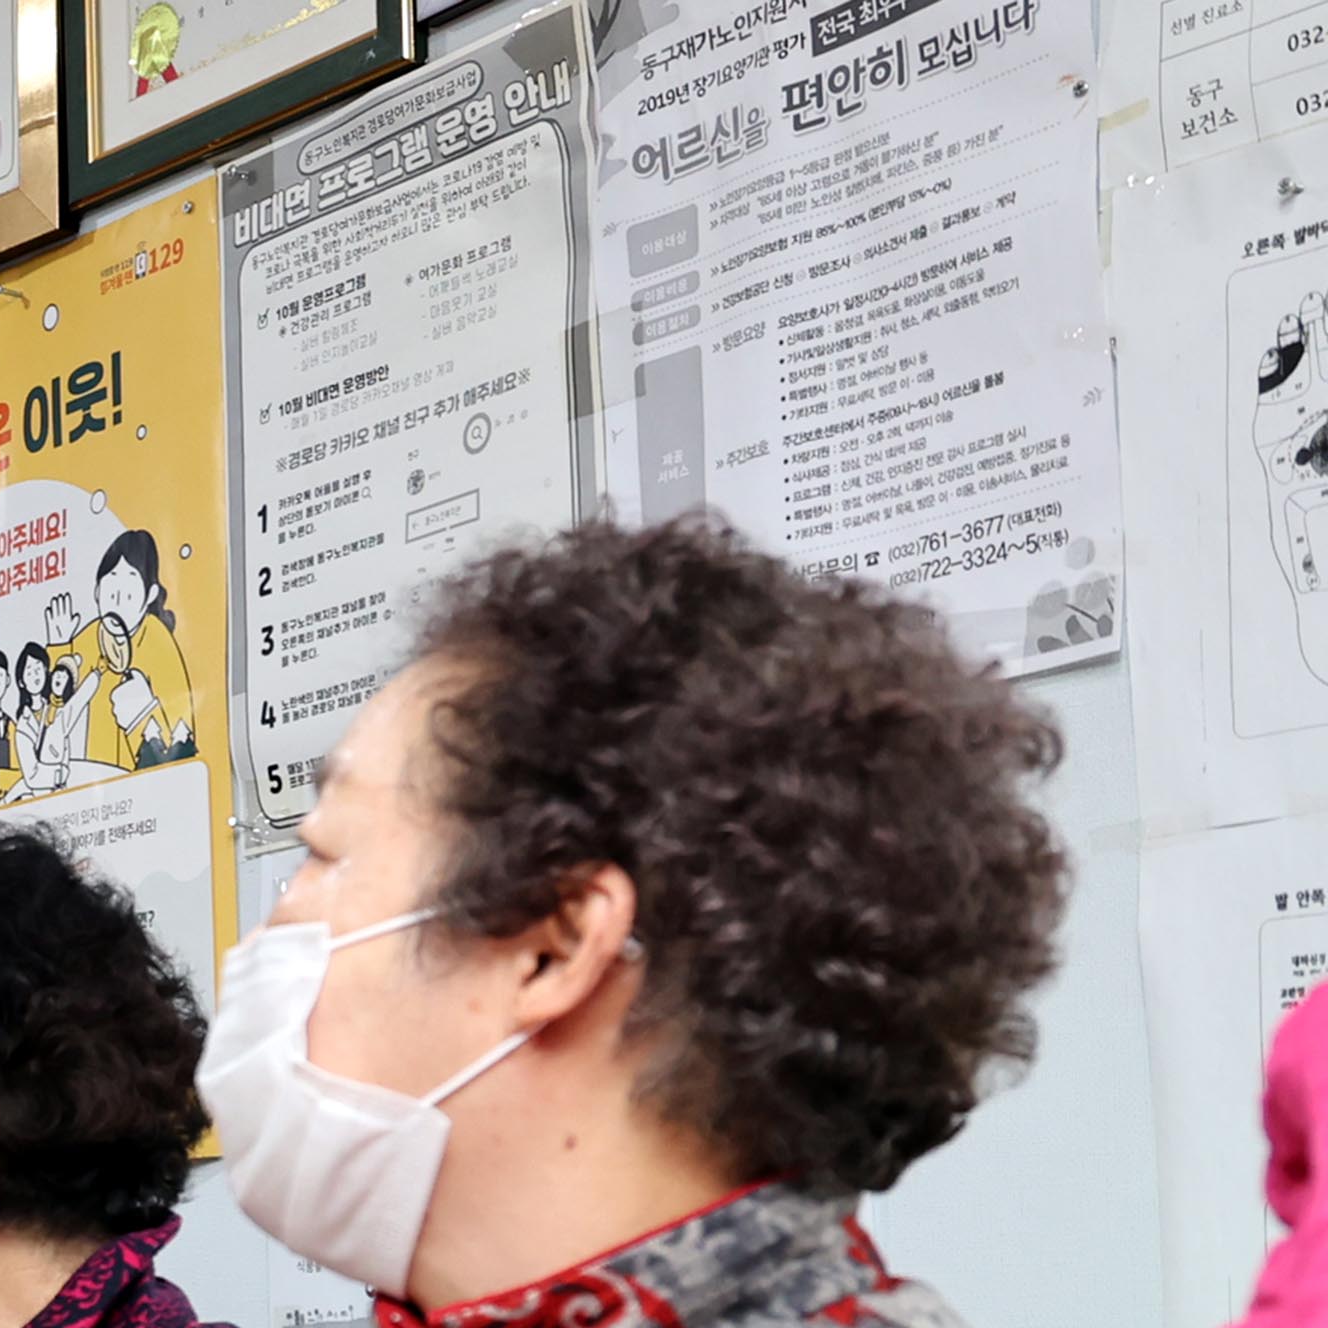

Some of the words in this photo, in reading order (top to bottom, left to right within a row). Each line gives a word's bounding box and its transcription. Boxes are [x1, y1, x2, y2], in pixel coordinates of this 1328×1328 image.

[1171, 13, 1195, 36] 선별
[1202, 0, 1243, 25] 진료소
[1287, 25, 1328, 52] 032
[636, 81, 691, 117] 2019년
[692, 46, 771, 99] 장기요양기관
[773, 33, 807, 61] 평가
[816, 4, 853, 48] 전국
[631, 104, 769, 183] 어르신을
[782, 38, 907, 131] 편안히
[916, 0, 1036, 77] 모십니다
[1187, 78, 1223, 108] 동구
[304, 124, 366, 168] 동구노인복지관
[367, 67, 478, 137] 경로당여가문화보급사업
[1181, 107, 1238, 140] 보건소
[233, 179, 312, 247] 비대면
[317, 124, 433, 210] 프로그램
[434, 93, 498, 158] 운영
[503, 61, 572, 126] 안내
[149, 238, 184, 274] 129
[466, 234, 511, 266] 프로그램
[1241, 233, 1285, 259] 오른쪽
[276, 299, 299, 323] 10월
[302, 271, 366, 313] 운영프로그램
[332, 290, 371, 319] 프로그램
[22, 350, 124, 454] 이웃!
[278, 395, 303, 418] 10월
[306, 382, 340, 408] 비대면
[343, 364, 389, 395] 운영방안
[329, 425, 369, 457] 카카오
[373, 414, 399, 442] 채널
[403, 404, 429, 432] 친구
[433, 392, 461, 420] 추가
[257, 503, 267, 534] 1
[1007, 502, 1062, 531] (대표전화)
[258, 564, 272, 597] 2
[261, 624, 274, 656] 3
[260, 699, 275, 731] 4
[267, 763, 282, 794] 5
[81, 808, 99, 824] 있지
[100, 799, 132, 820] 않나요?
[109, 819, 156, 843] 전해주세요!
[1275, 892, 1288, 911] 발
[1296, 888, 1326, 908] 안쪽
